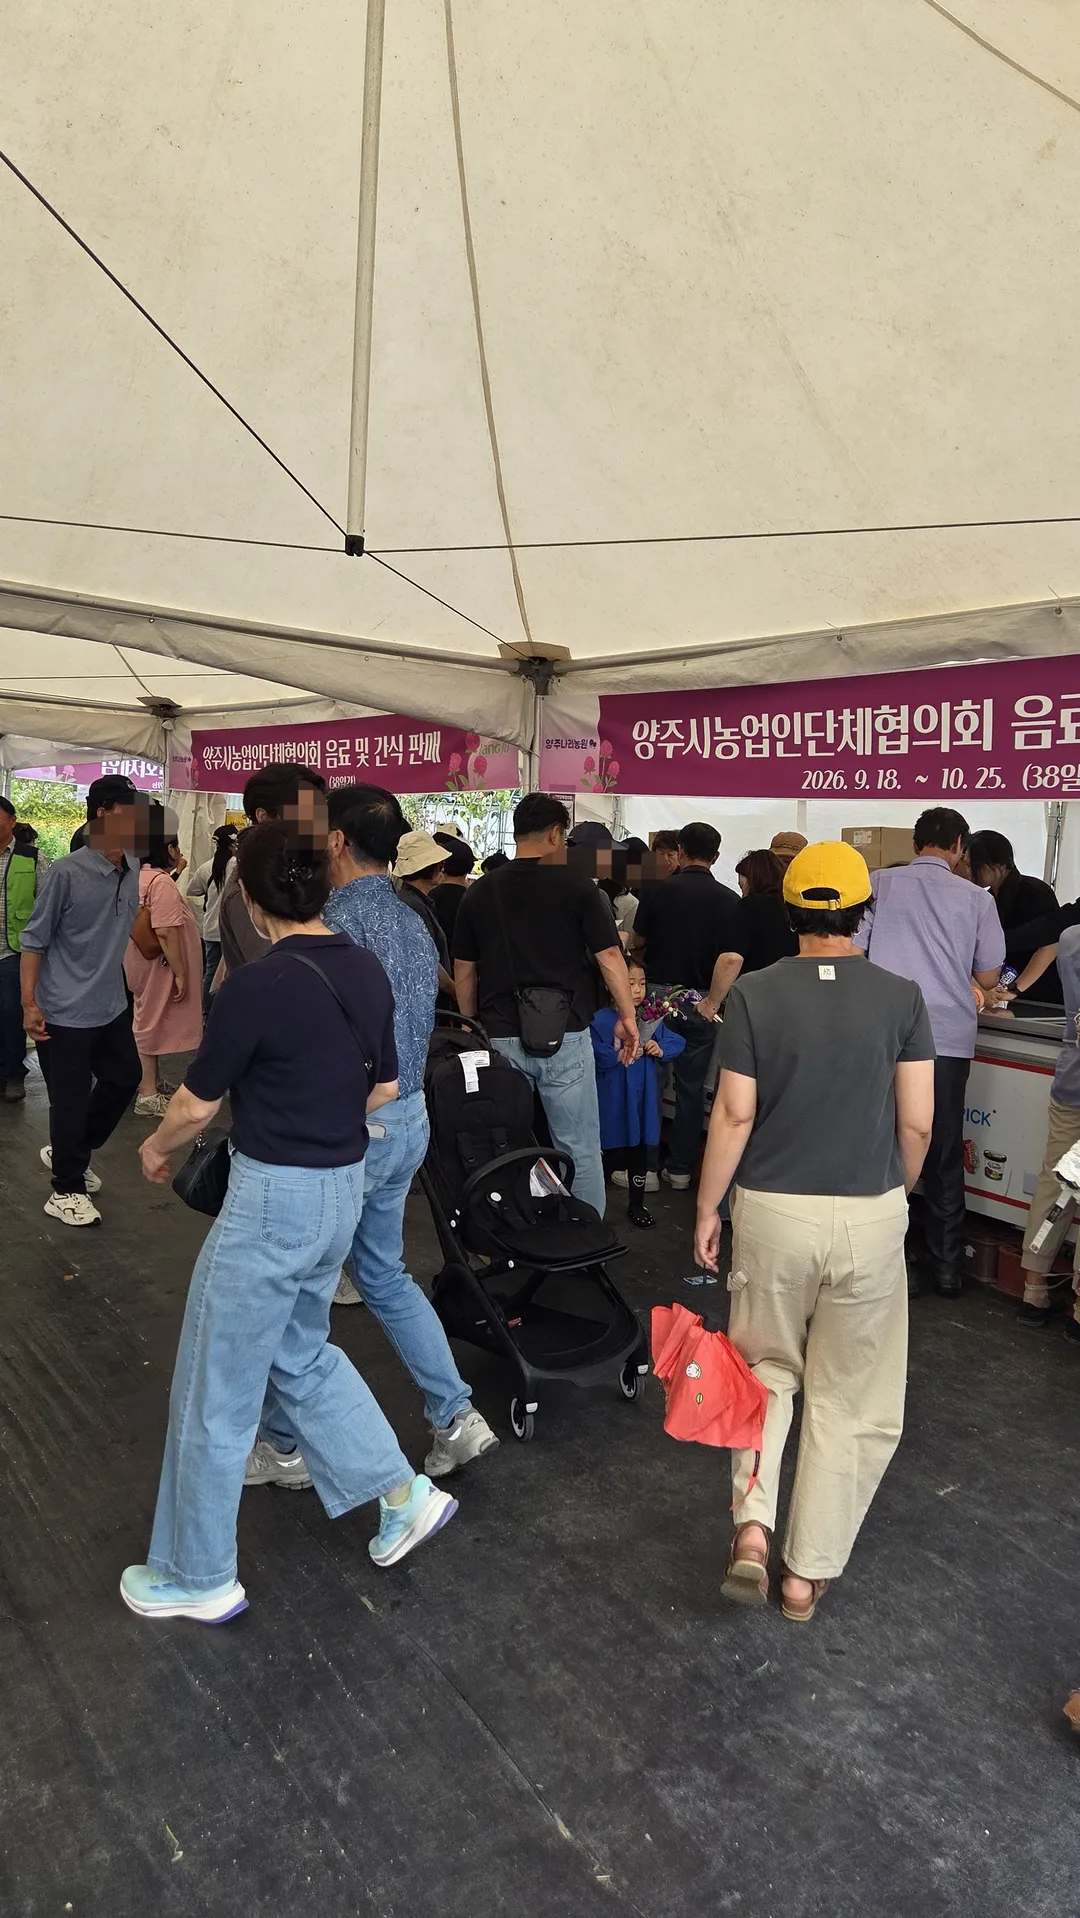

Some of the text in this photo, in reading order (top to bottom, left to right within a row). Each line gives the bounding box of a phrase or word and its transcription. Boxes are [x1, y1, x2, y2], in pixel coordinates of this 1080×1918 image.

[545, 739, 589, 750] 양주나리농원
[632, 698, 994, 760] 양주시농업인단체협의회
[325, 738, 352, 769] 음료
[355, 736, 370, 768] 및
[373, 734, 404, 767] 간식
[408, 731, 441, 765] 판매
[801, 769, 848, 790] 2026.
[854, 769, 870, 790] 9.
[876, 768, 902, 790] 18.
[941, 767, 968, 790] 10.
[974, 766, 1006, 790] 25.
